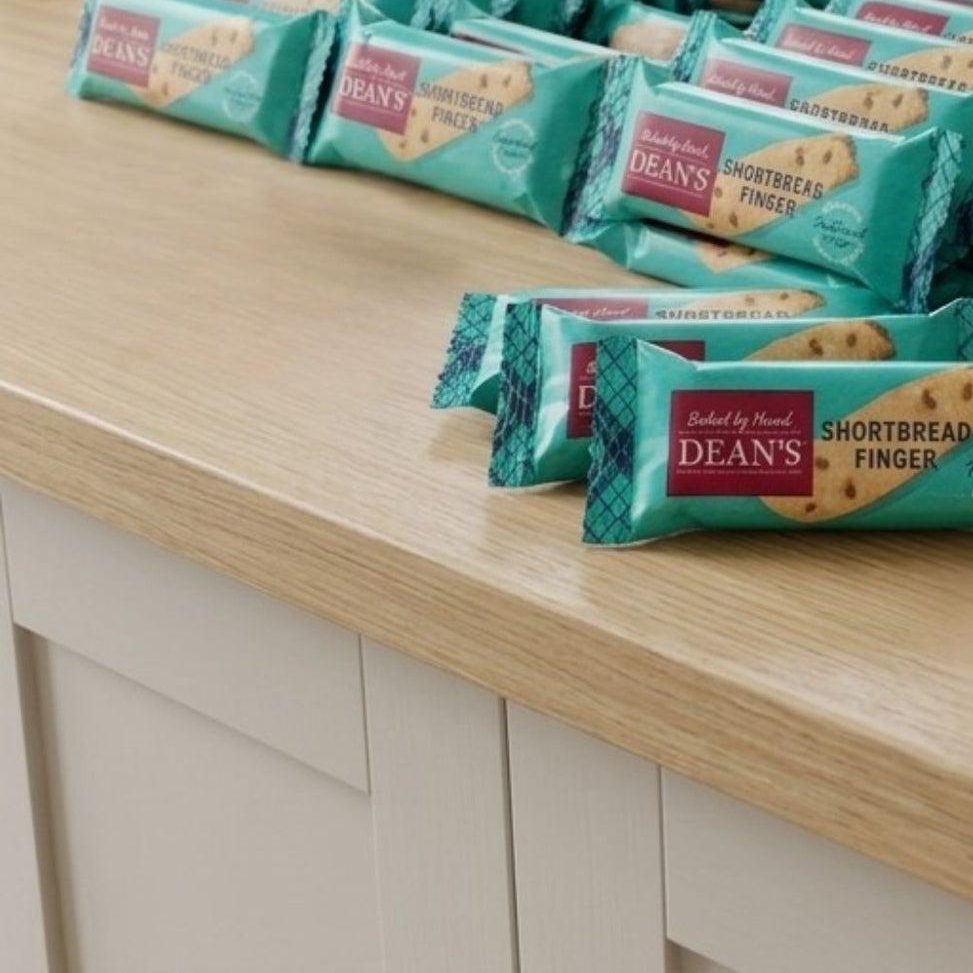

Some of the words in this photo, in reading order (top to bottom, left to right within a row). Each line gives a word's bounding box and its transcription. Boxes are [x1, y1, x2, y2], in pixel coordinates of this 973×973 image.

[629, 148, 712, 192] DEAN'S
[821, 421, 971, 443] SHORTBREAD
[678, 438, 801, 466] DEAN'S
[855, 448, 938, 470] FINGER
